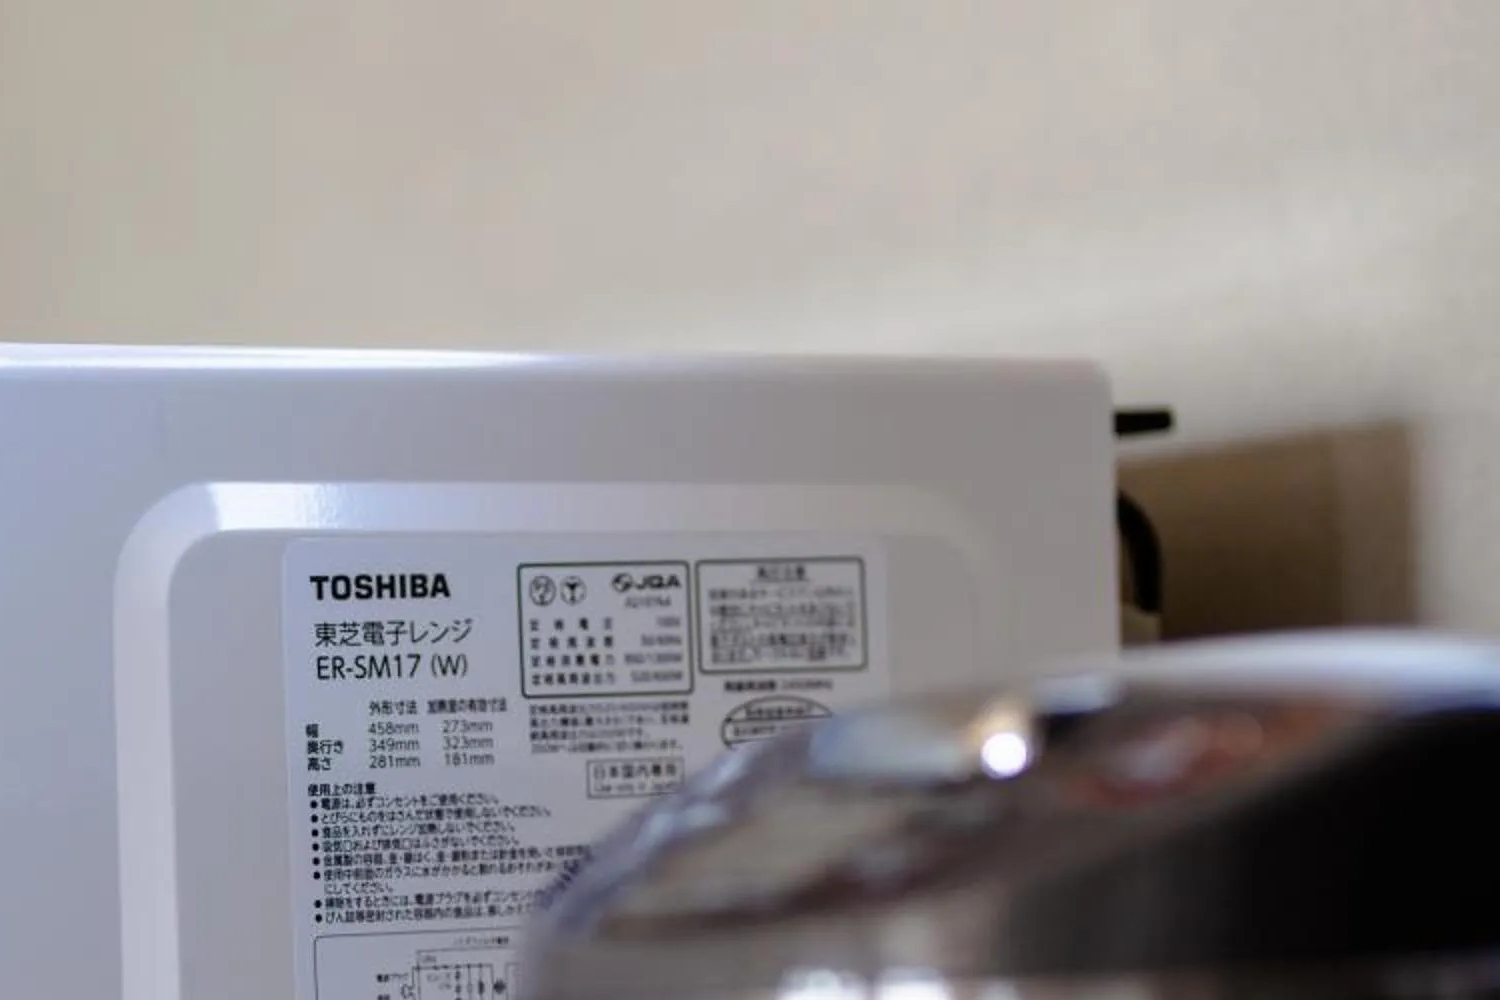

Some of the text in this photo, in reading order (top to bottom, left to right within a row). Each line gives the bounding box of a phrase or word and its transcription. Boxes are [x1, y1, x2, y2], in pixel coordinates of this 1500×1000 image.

[310, 573, 451, 601] TOSHIBA
[314, 617, 473, 647] 東芝電子レンジ
[316, 652, 469, 680] ER-SM17 (W)
[368, 700, 418, 716] 外形寸法
[368, 721, 419, 735] 458mm
[442, 719, 493, 733] 273mm
[369, 737, 420, 752] 349mm
[442, 735, 494, 750] 323mm
[307, 752, 495, 771] 高さ 281mm 181mm
[308, 782, 375, 798] 使用上の注意
